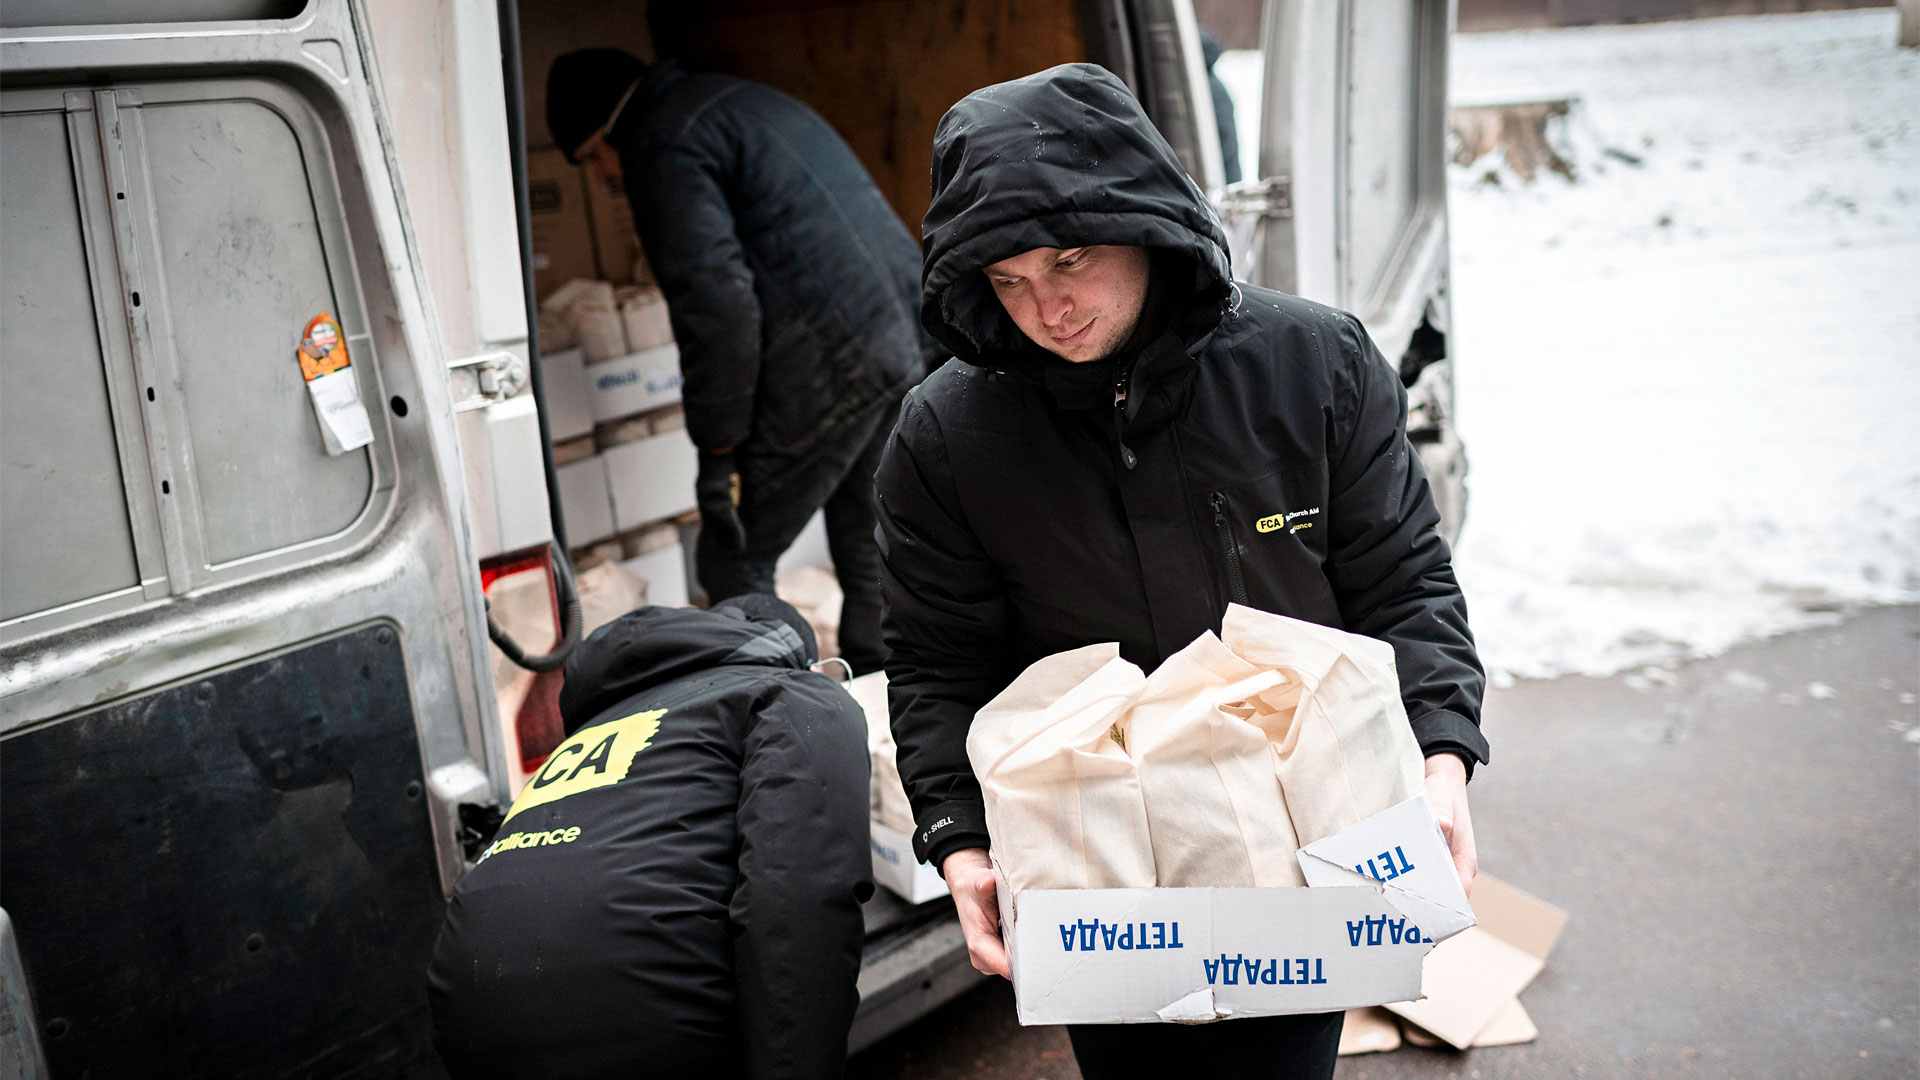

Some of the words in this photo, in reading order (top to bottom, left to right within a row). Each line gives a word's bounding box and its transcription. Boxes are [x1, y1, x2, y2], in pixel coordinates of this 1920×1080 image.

[1260, 519, 1281, 529] FCA
[532, 732, 619, 789] CA
[1355, 846, 1415, 883] ТЕТ
[1059, 918, 1184, 952] ТЕТРАДА
[1203, 953, 1327, 985] ТЕТРАДА
